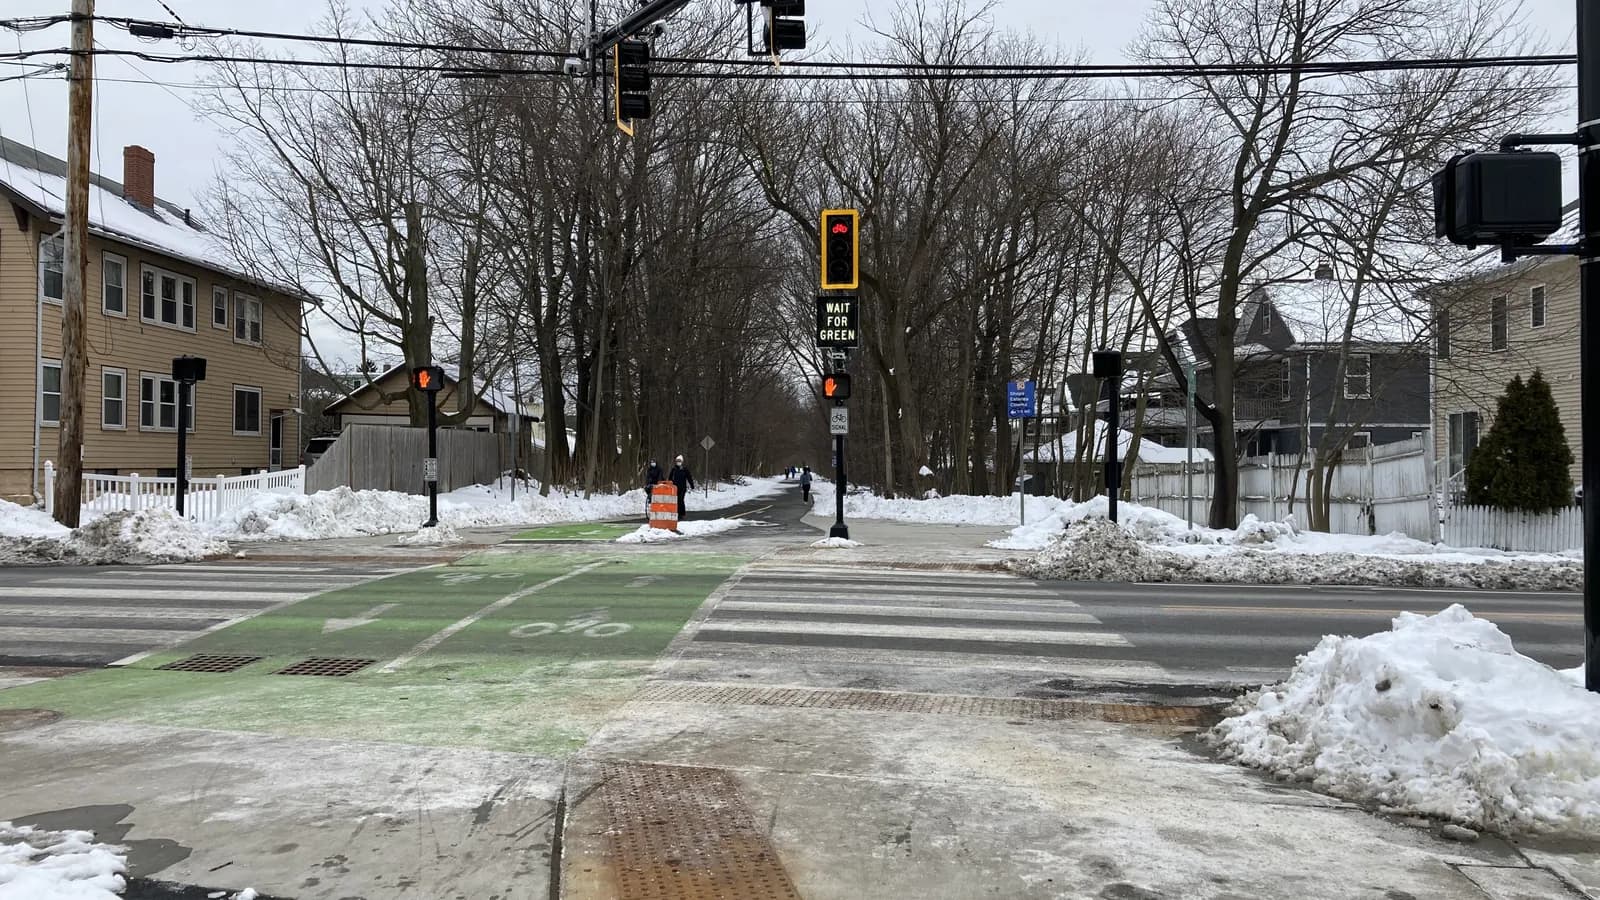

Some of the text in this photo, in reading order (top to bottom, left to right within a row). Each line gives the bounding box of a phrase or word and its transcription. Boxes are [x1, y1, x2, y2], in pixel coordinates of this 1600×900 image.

[826, 303, 850, 313] WAIT
[827, 316, 848, 327] FOR
[820, 330, 855, 341] GREEN
